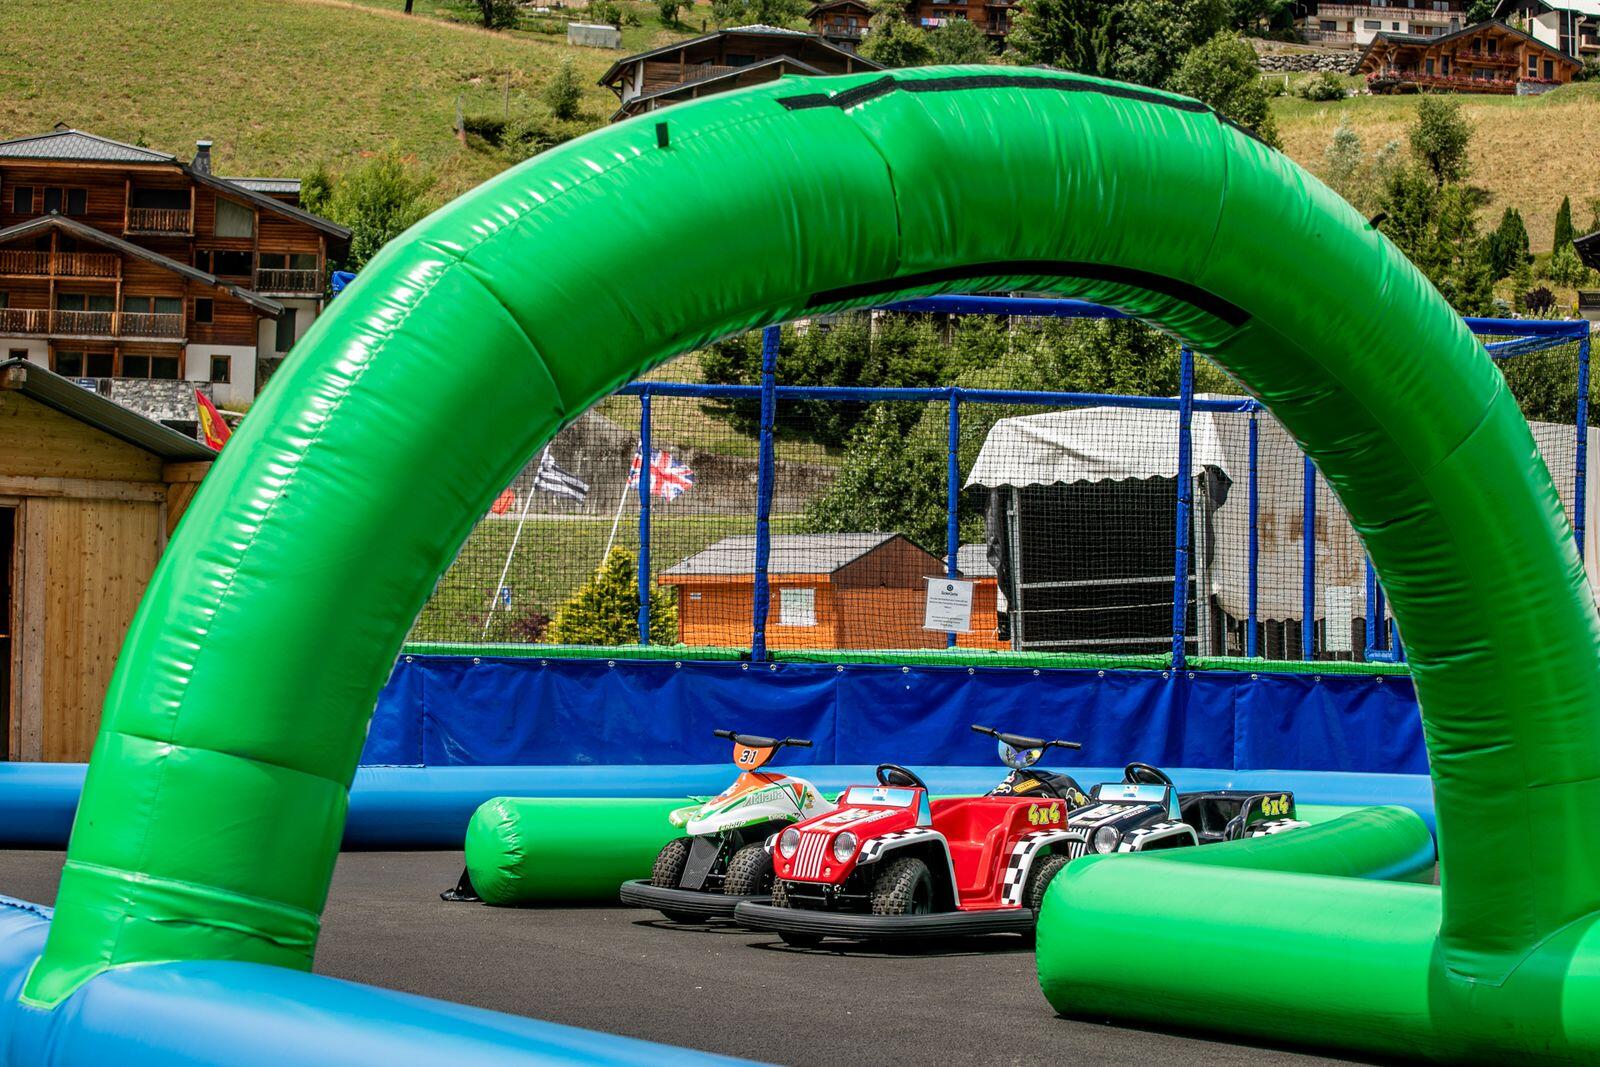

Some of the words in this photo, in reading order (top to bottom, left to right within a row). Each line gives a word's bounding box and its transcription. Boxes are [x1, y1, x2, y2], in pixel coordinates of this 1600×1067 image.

[739, 749, 758, 764] 31
[1028, 802, 1060, 826] 4x4
[1261, 794, 1288, 816] 4x4
